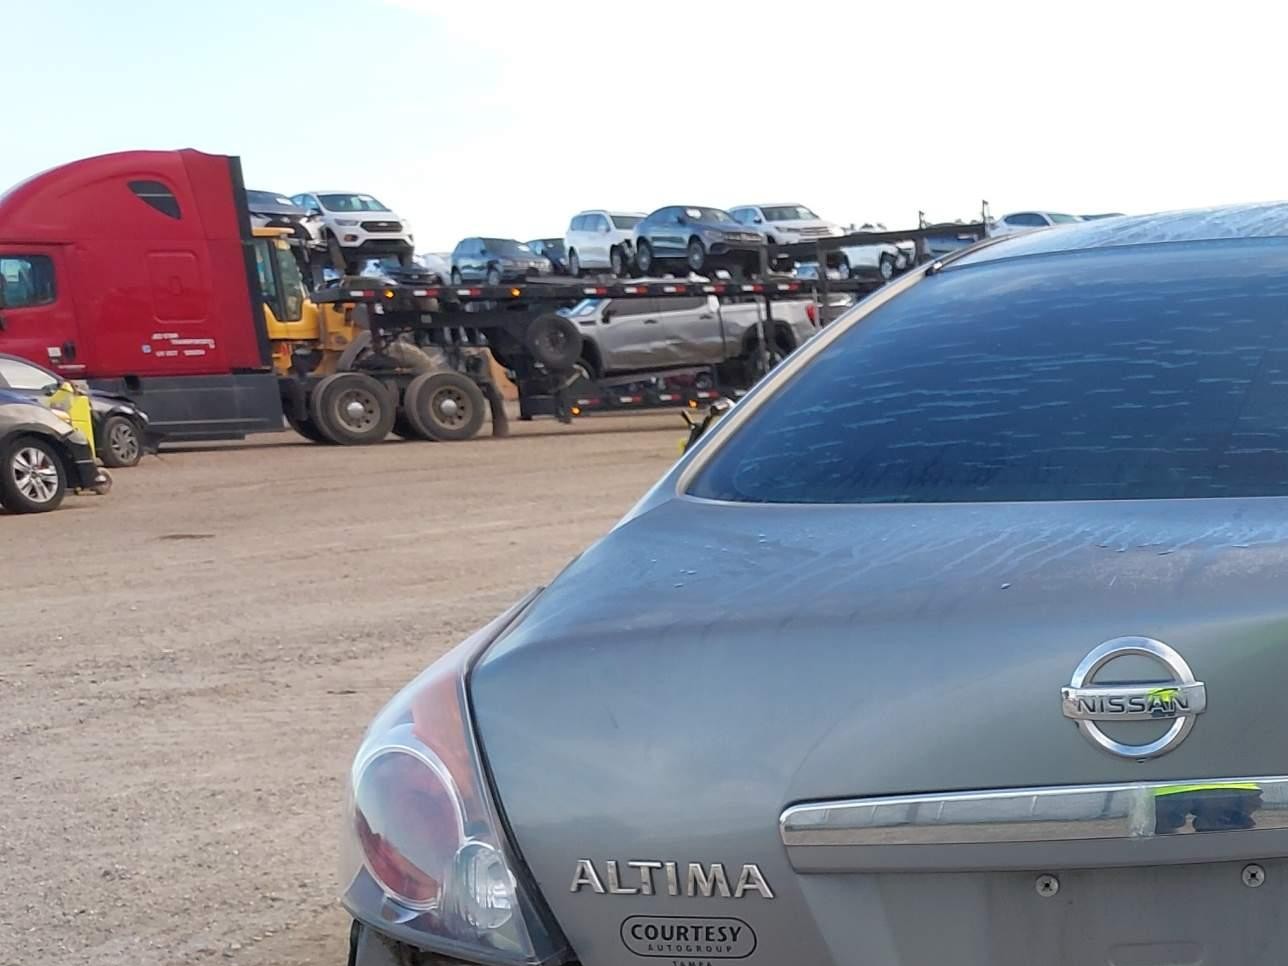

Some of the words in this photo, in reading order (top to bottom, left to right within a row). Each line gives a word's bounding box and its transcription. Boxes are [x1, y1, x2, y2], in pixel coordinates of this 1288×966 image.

[1076, 694, 1190, 714] NISSAN
[570, 858, 775, 899] ALTIMA
[631, 923, 742, 942] COURTESY
[648, 943, 733, 953] AUTOGROUP
